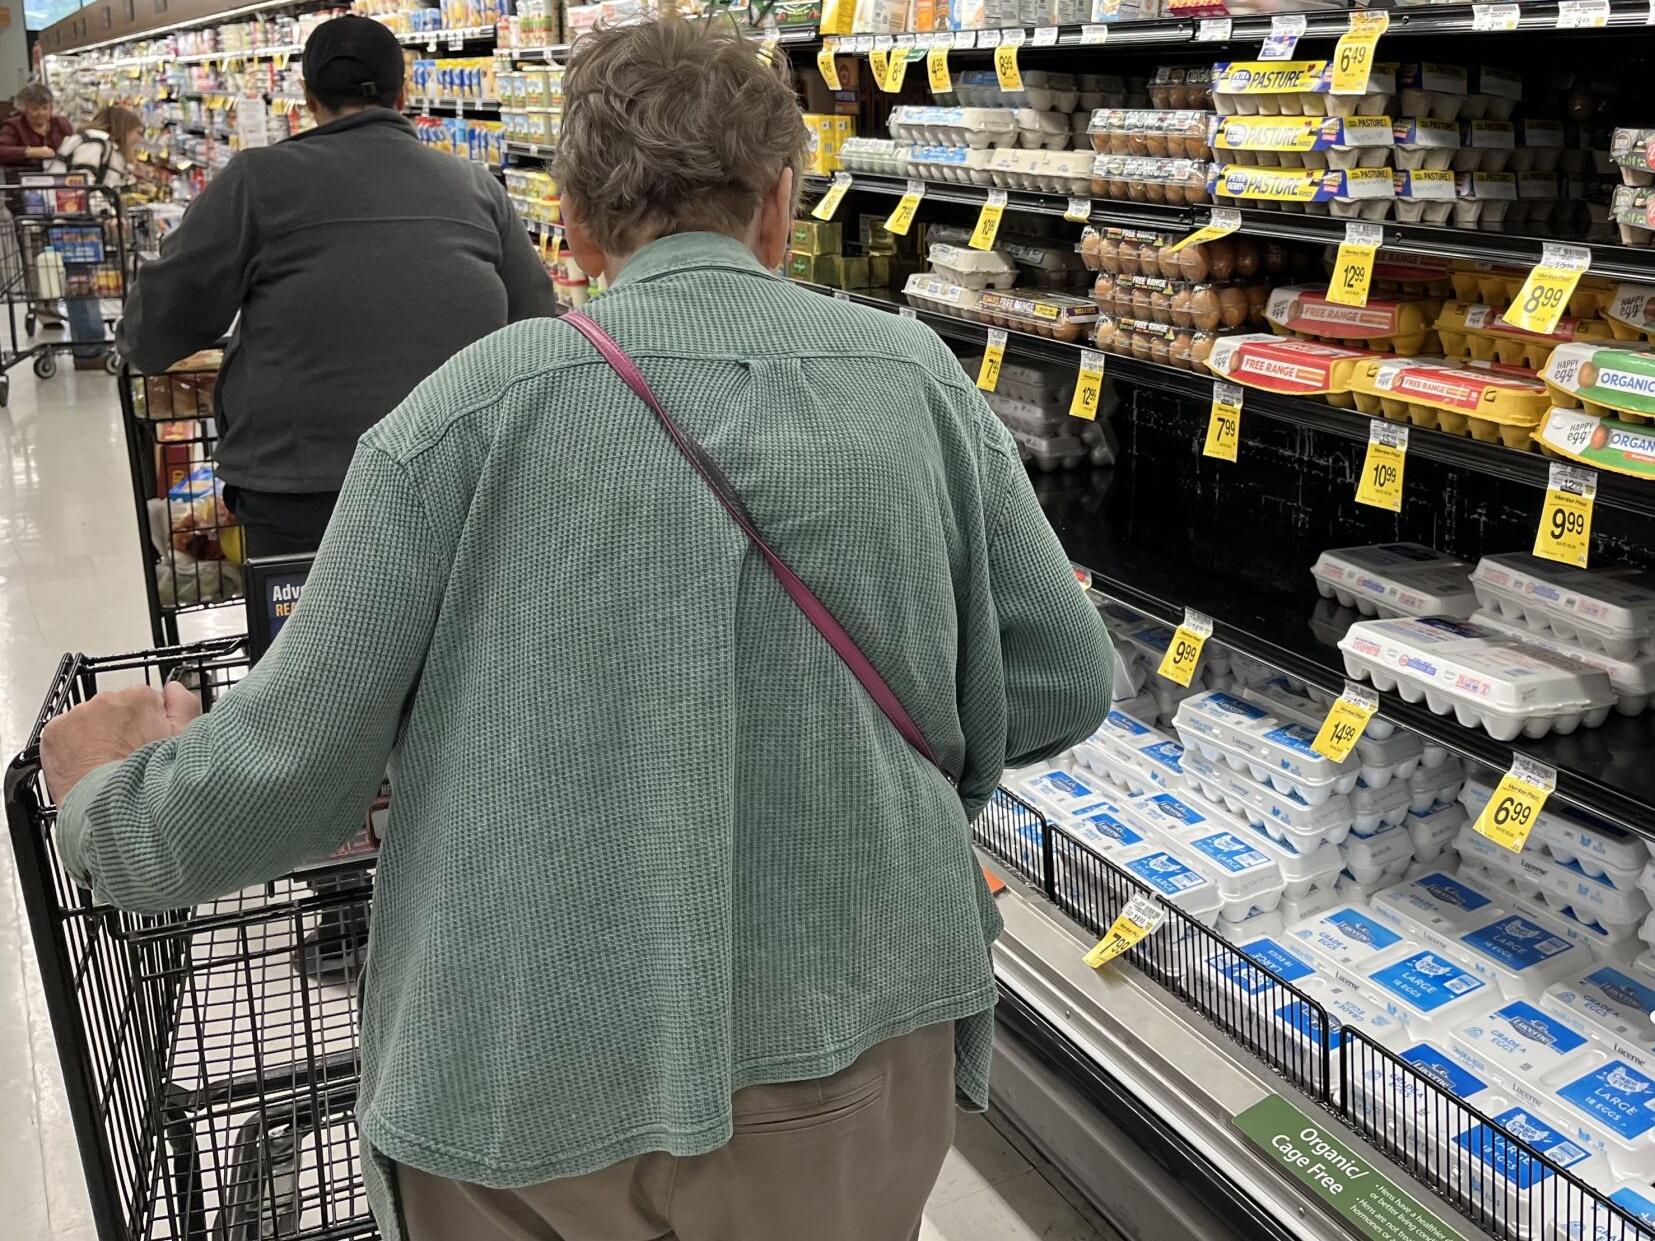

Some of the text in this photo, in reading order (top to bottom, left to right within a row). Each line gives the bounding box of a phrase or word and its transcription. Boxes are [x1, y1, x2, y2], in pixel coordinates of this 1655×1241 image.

[1340, 46, 1367, 73] 649
[1249, 71, 1305, 88] PASTURE
[1247, 175, 1301, 196] PASTURE
[1343, 264, 1366, 289] 1299
[1523, 284, 1564, 314] 899
[1621, 294, 1645, 307] HAPPY
[1303, 306, 1360, 323] FREE RANGE
[1618, 303, 1641, 319] egg
[1243, 357, 1296, 378] FREE RANGE
[1554, 367, 1574, 383] egg
[1557, 358, 1580, 370] HAPPY
[1403, 376, 1446, 395] FREE RANGE
[1600, 371, 1655, 394] ORGANIC
[1216, 416, 1236, 443] 799
[1567, 429, 1590, 446] egg
[1569, 421, 1594, 432] HAPPY
[1373, 463, 1397, 488] 1099
[1550, 507, 1585, 540] 999
[1173, 640, 1197, 665] 999
[1329, 720, 1356, 745] 1499
[1493, 796, 1533, 826] 699
[1216, 853, 1243, 870] LARGE
[1520, 858, 1549, 876] Lucerne
[1151, 874, 1177, 895] LARGE
[1492, 934, 1528, 954] LARGE
[1335, 970, 1360, 992] Lucerne
[1391, 978, 1422, 999] 18 EGGS
[1401, 971, 1438, 994] LARGE
[1583, 994, 1614, 1012] GRADE
[1583, 1001, 1609, 1018] EGGS
[1490, 1029, 1522, 1049] GRADE
[1512, 1016, 1551, 1044] Lucerne
[1490, 1037, 1516, 1054] EGGS
[1613, 1042, 1647, 1067] Lucerne
[1414, 1062, 1450, 1089] Lucerne
[1512, 1081, 1543, 1106] Lucerne
[1594, 1087, 1639, 1116] LARGE
[1584, 1096, 1622, 1121] 18 EGGS
[1271, 1134, 1344, 1195] Cage Free
[1299, 1127, 1371, 1180] Organic/
[1350, 1204, 1392, 1240] hormones or
[1359, 1199, 1377, 1215] Hens
[1374, 1213, 1387, 1224] are
[1385, 1221, 1400, 1233] not
[1369, 1192, 1380, 1200] or
[1377, 1198, 1399, 1216] better
[1397, 1213, 1417, 1232] living
[1378, 1185, 1397, 1202] Hens
[1395, 1198, 1412, 1214] have
[1415, 1215, 1447, 1240] healthier
